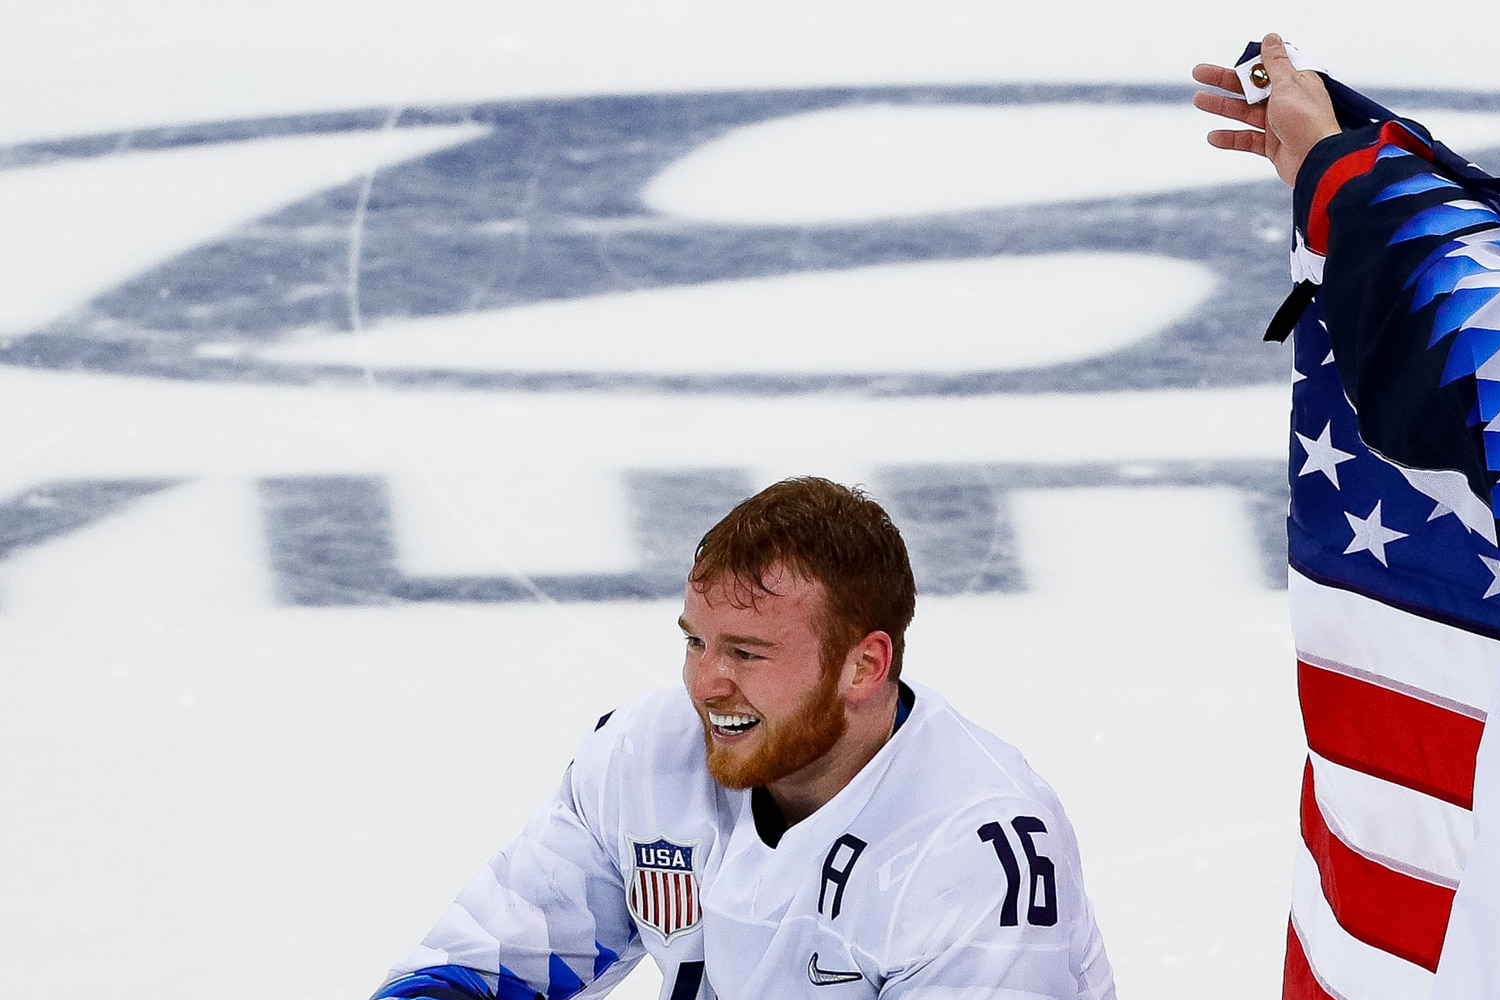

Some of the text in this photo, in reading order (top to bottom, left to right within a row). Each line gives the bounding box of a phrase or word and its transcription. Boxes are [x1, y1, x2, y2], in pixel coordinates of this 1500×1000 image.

[641, 846, 687, 870] USA
[817, 832, 869, 921] A
[976, 814, 1059, 928] 16
